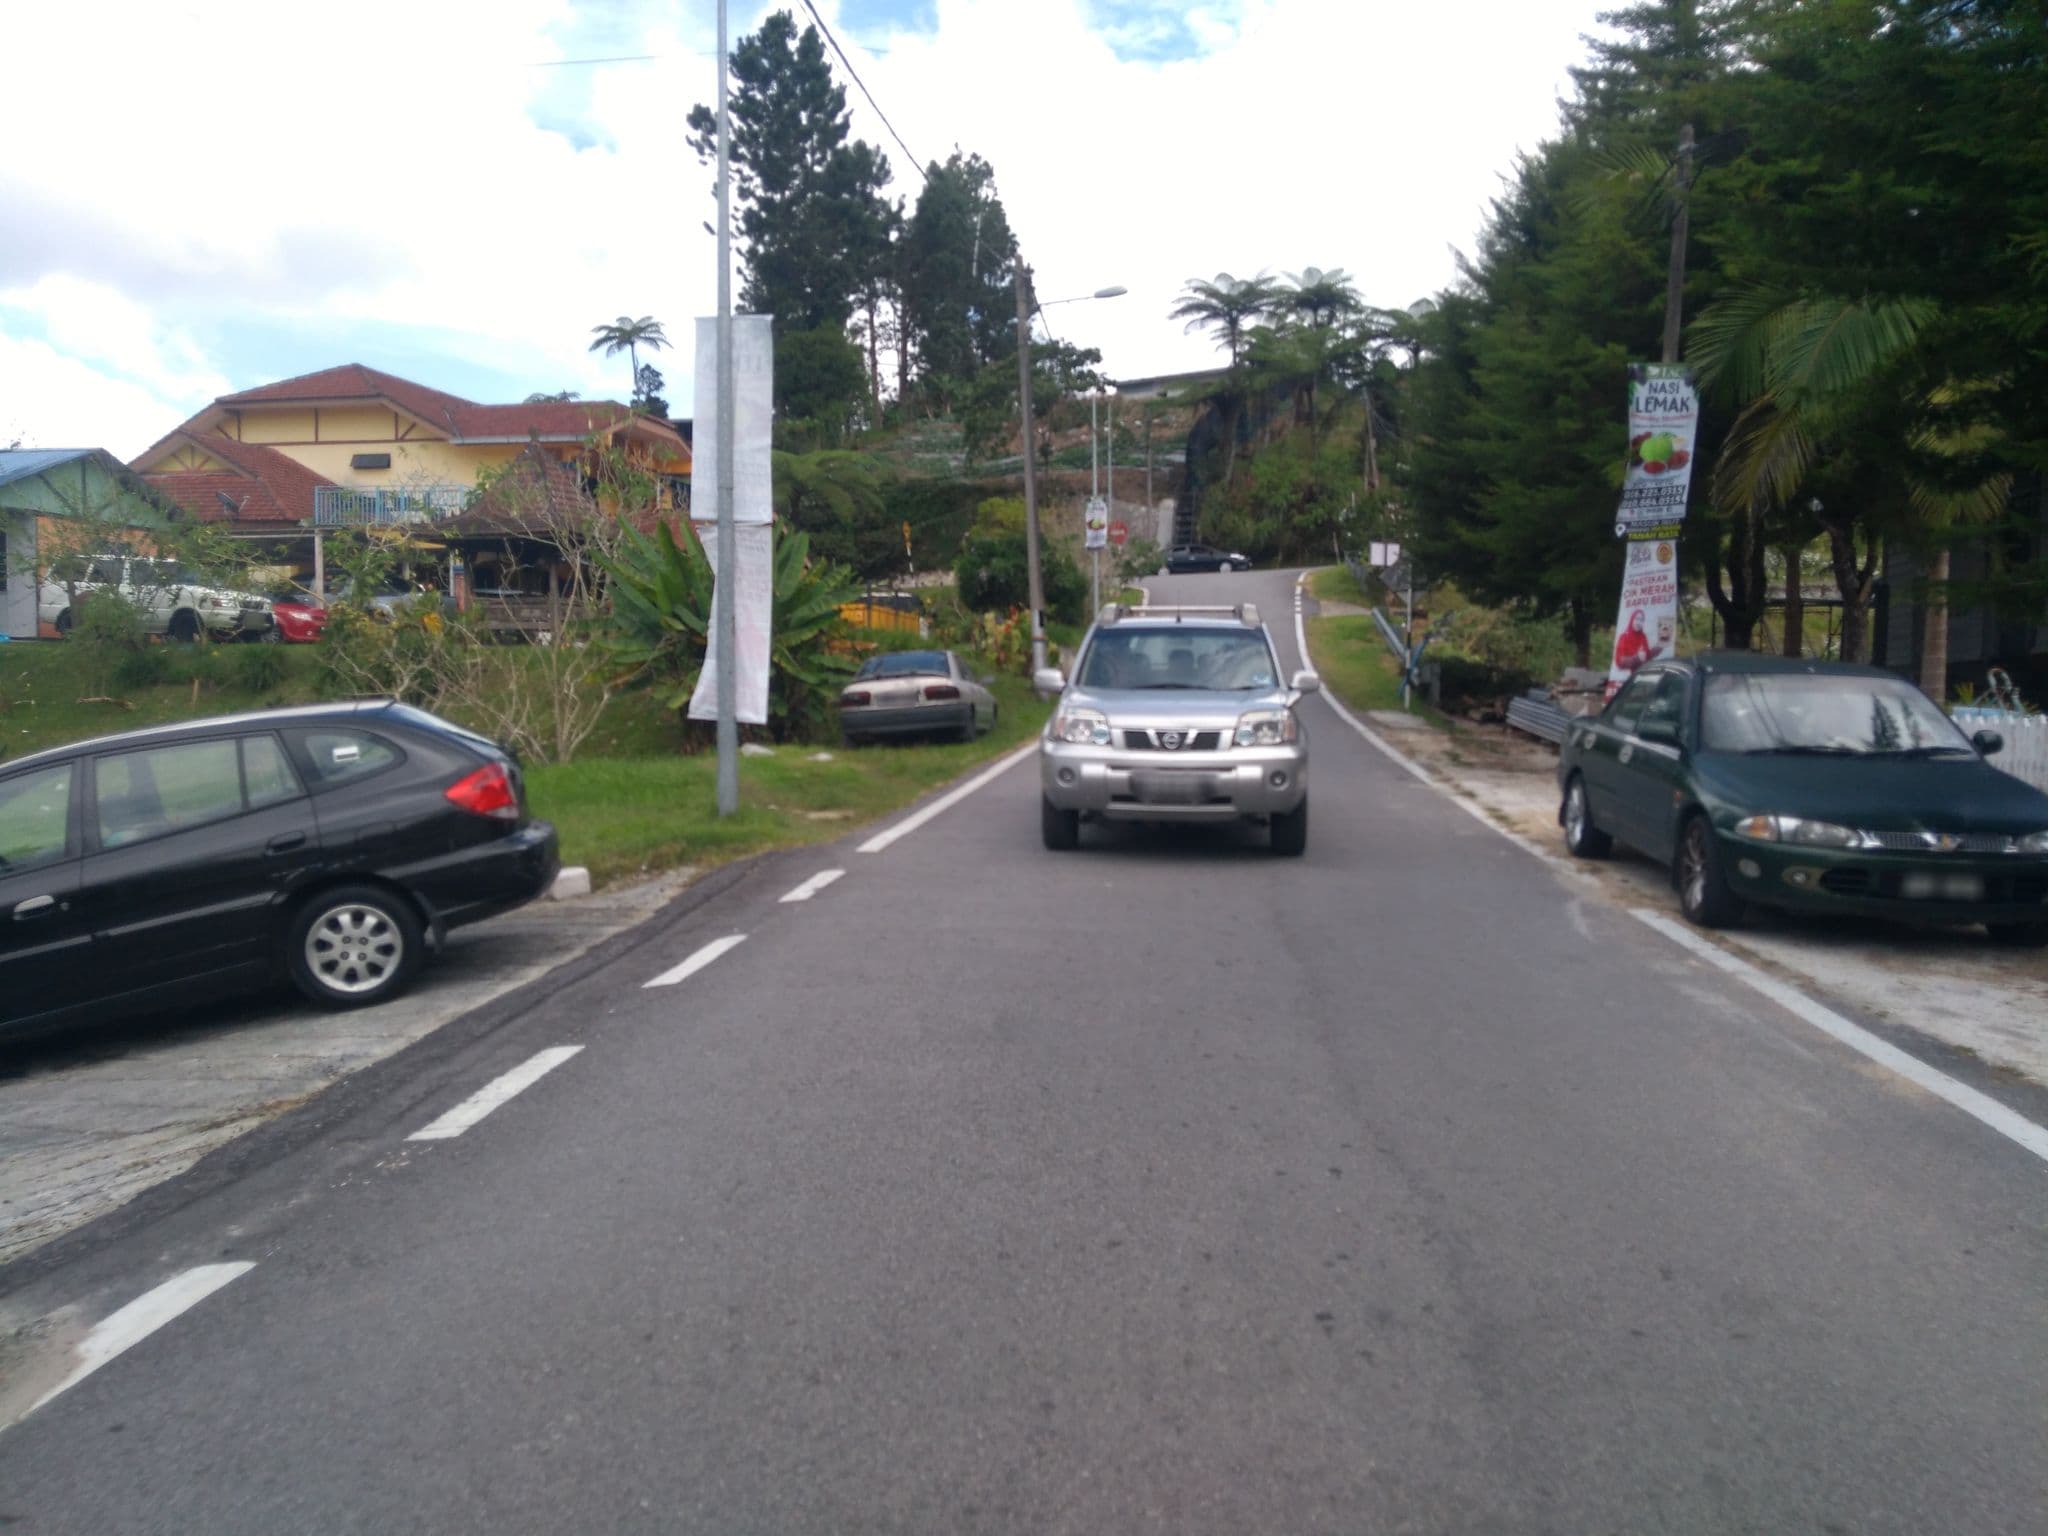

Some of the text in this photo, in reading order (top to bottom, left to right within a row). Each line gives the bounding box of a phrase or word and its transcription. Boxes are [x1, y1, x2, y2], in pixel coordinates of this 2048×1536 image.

[1648, 381, 1680, 395] NASI
[1636, 396, 1690, 413] LEMAK
[1640, 584, 1675, 596] MERAH
